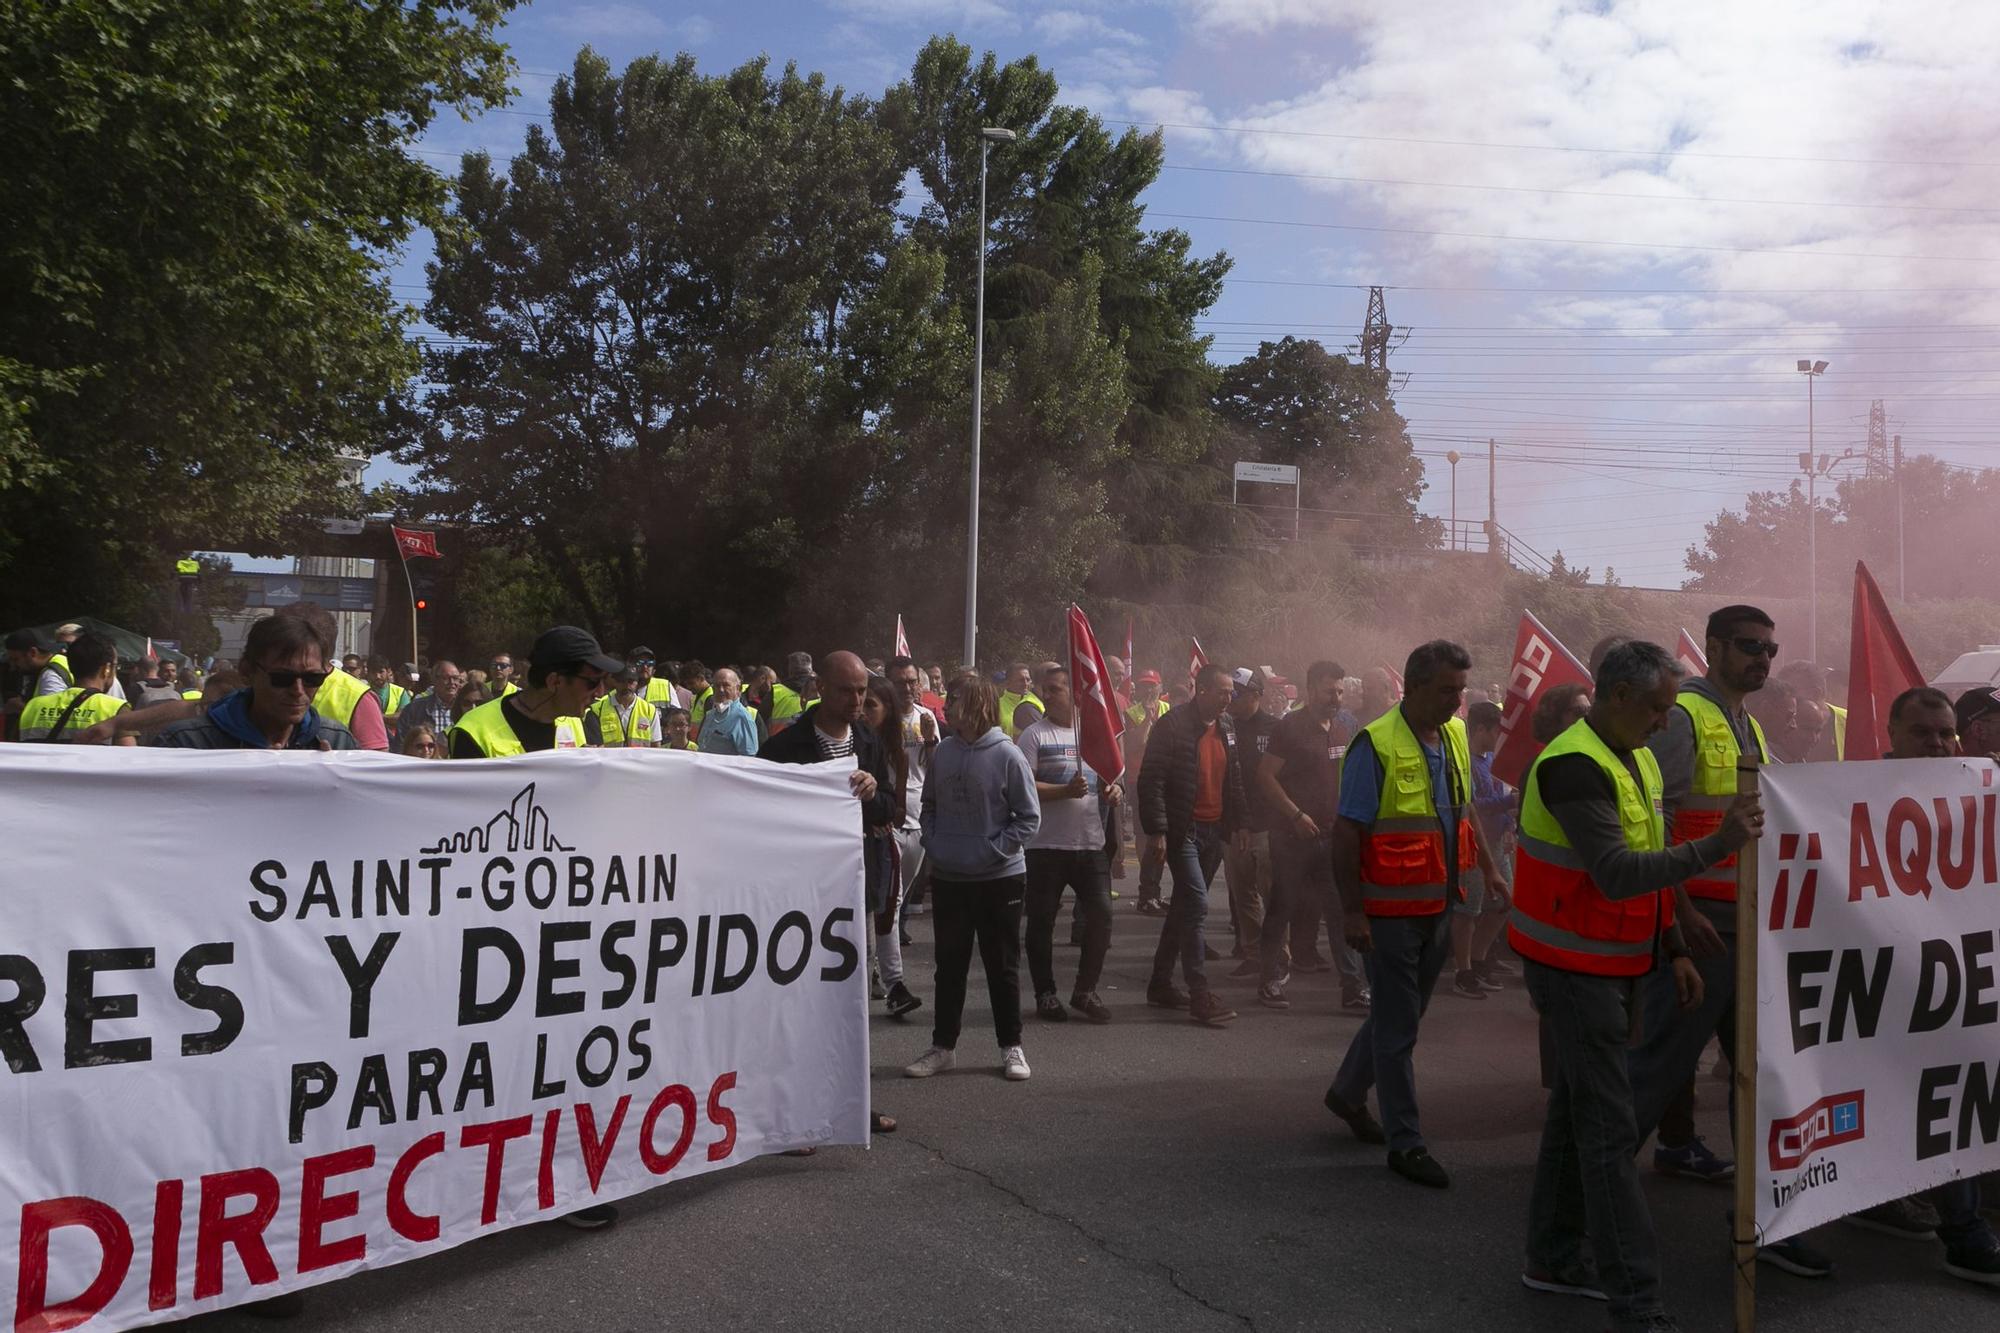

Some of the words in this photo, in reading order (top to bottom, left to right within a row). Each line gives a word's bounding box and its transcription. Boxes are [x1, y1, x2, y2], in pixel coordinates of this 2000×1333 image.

[40, 707, 95, 718] SEKRIT
[250, 854, 677, 922] SAINT-GOBAIN
[325, 932, 400, 1038] Y
[458, 908, 858, 1025] DESPIDOS
[1787, 946, 1894, 1054] EN
[289, 1042, 495, 1143] PARA
[532, 1019, 652, 1099] LOS
[14, 1071, 738, 1333] DIRECTIVOS
